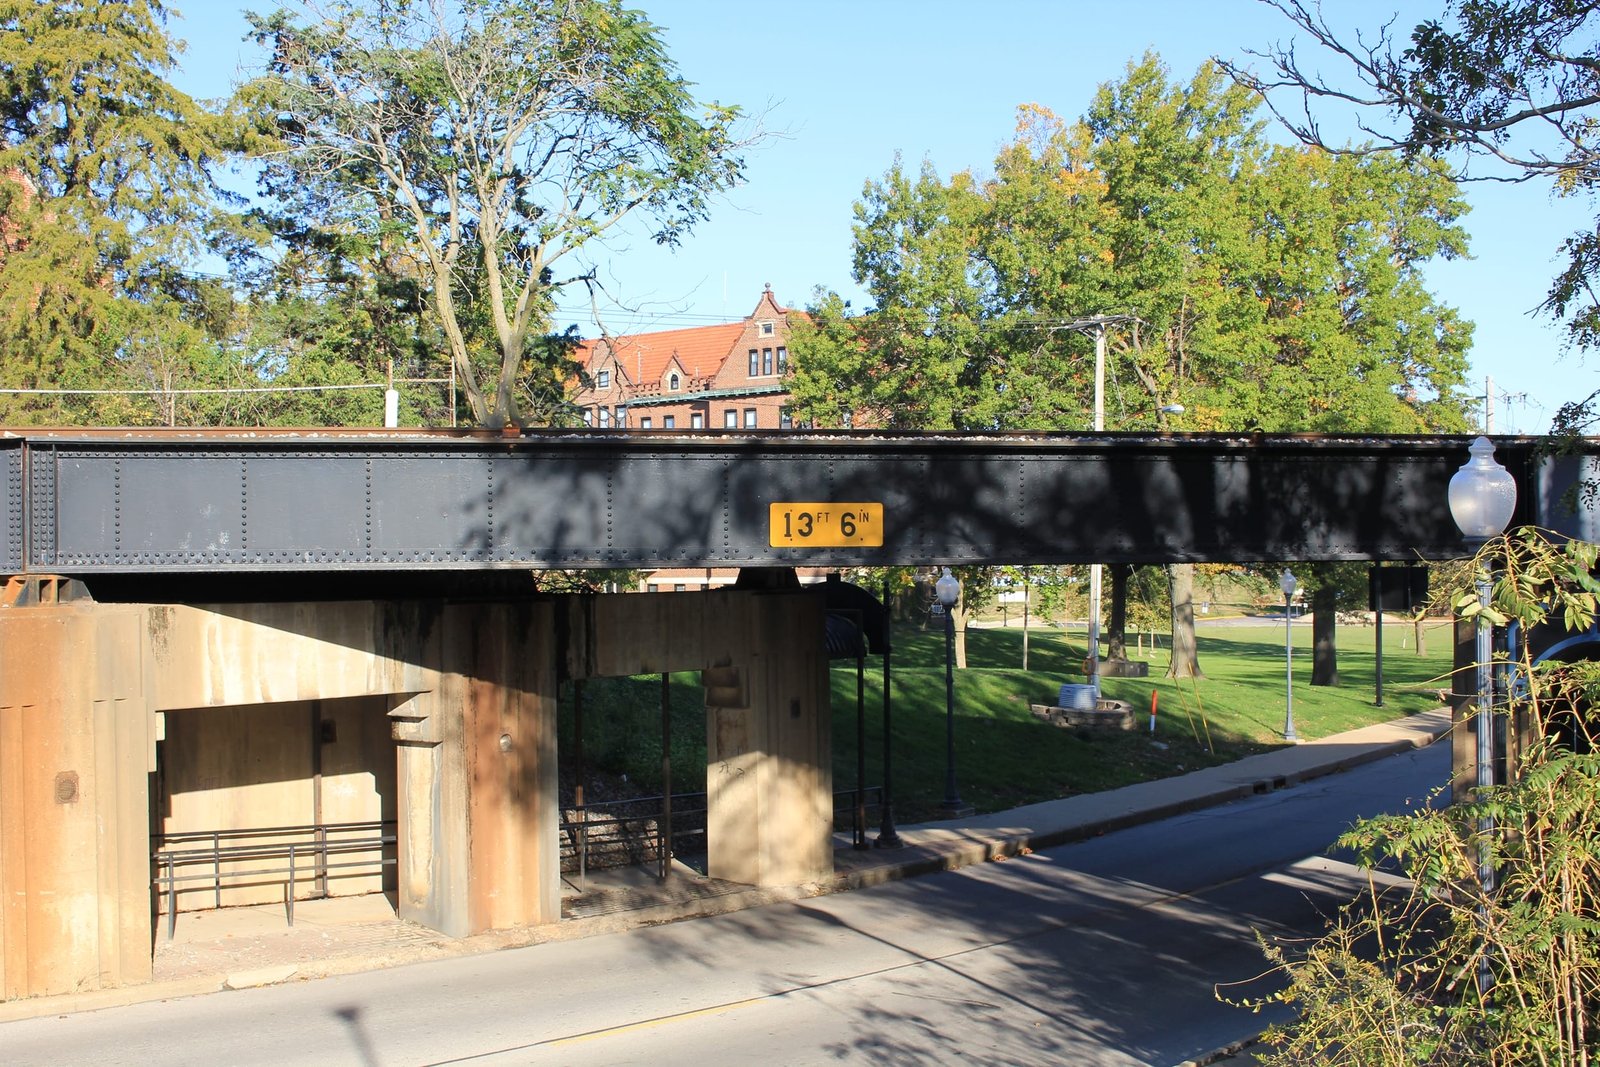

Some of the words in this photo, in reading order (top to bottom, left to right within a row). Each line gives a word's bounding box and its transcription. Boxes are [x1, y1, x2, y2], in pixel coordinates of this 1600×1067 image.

[784, 512, 813, 537] 13
[817, 512, 830, 522] FT
[841, 512, 856, 537] 6
[859, 512, 869, 522] IN
